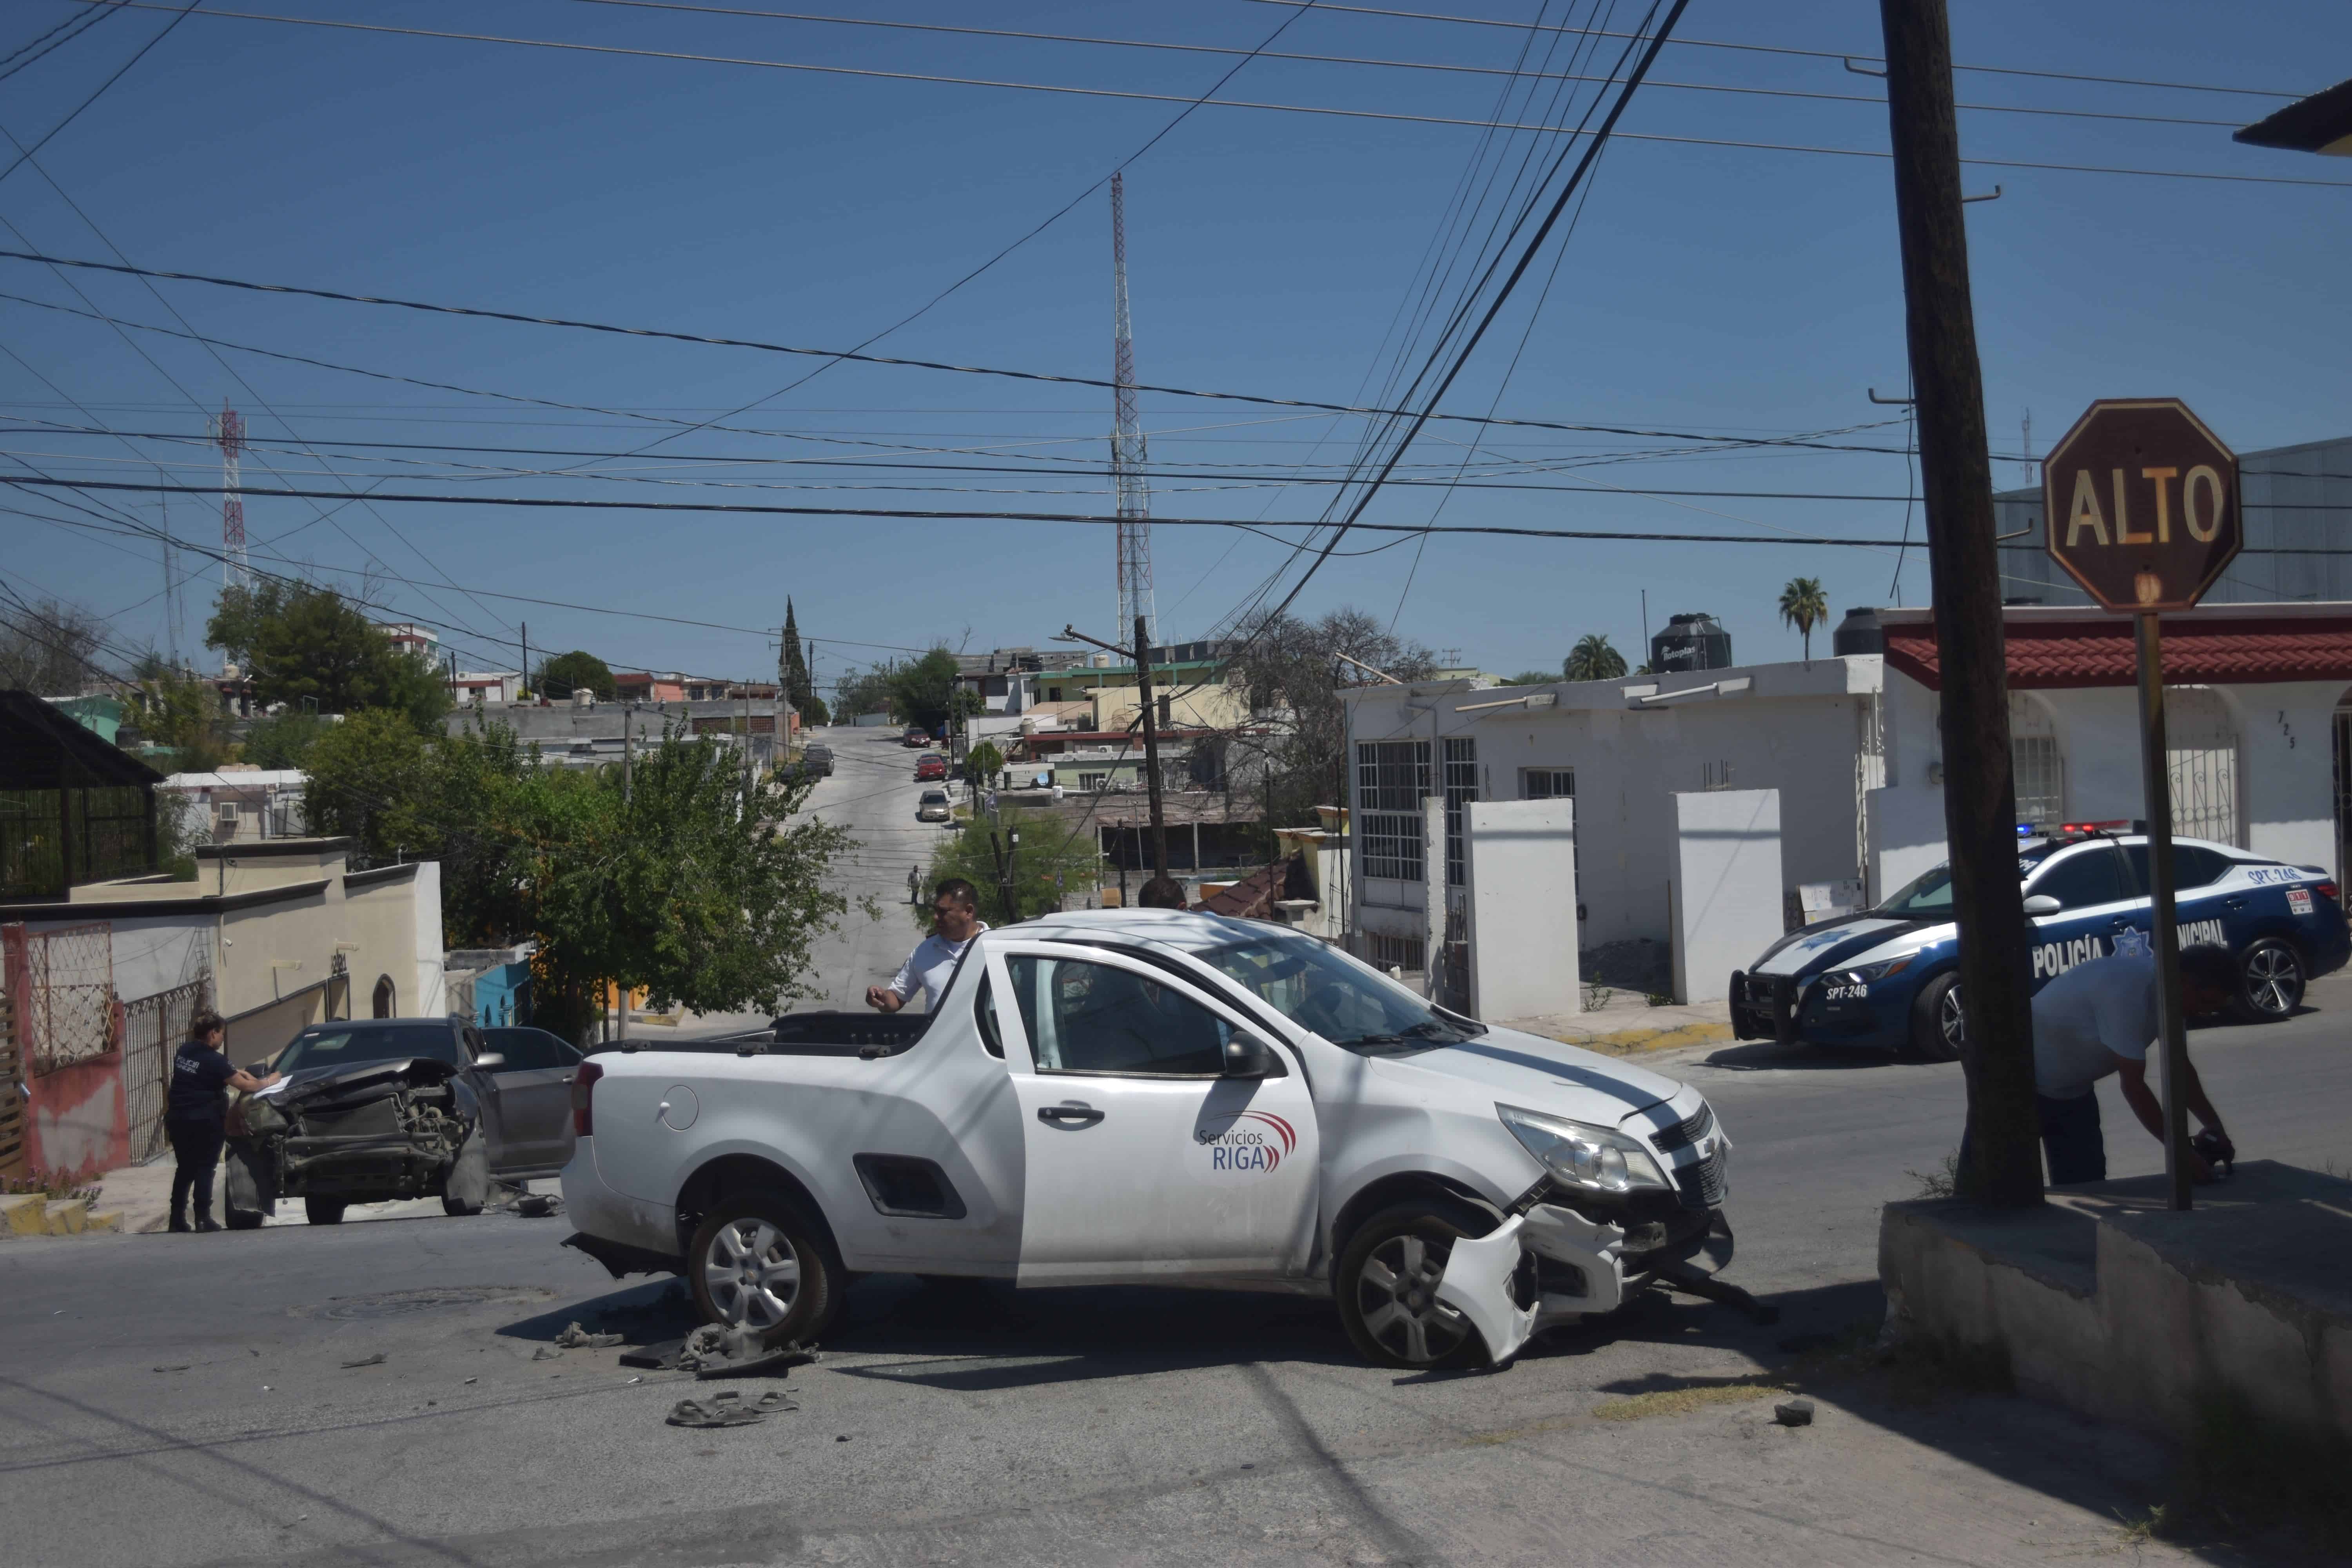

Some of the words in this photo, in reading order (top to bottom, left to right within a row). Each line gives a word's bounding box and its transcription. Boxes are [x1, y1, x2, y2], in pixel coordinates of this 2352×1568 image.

[2066, 465, 2223, 546] ALTO
[2248, 868, 2302, 884] SPT-246
[2289, 892, 2307, 901] 911
[2032, 934, 2102, 978] POLICÍA
[2176, 919, 2228, 951] NICIPAL
[1826, 984, 1867, 1000] SPT-246
[1199, 1130, 1263, 1145] Servicios
[1213, 1147, 1265, 1170] RIGA
